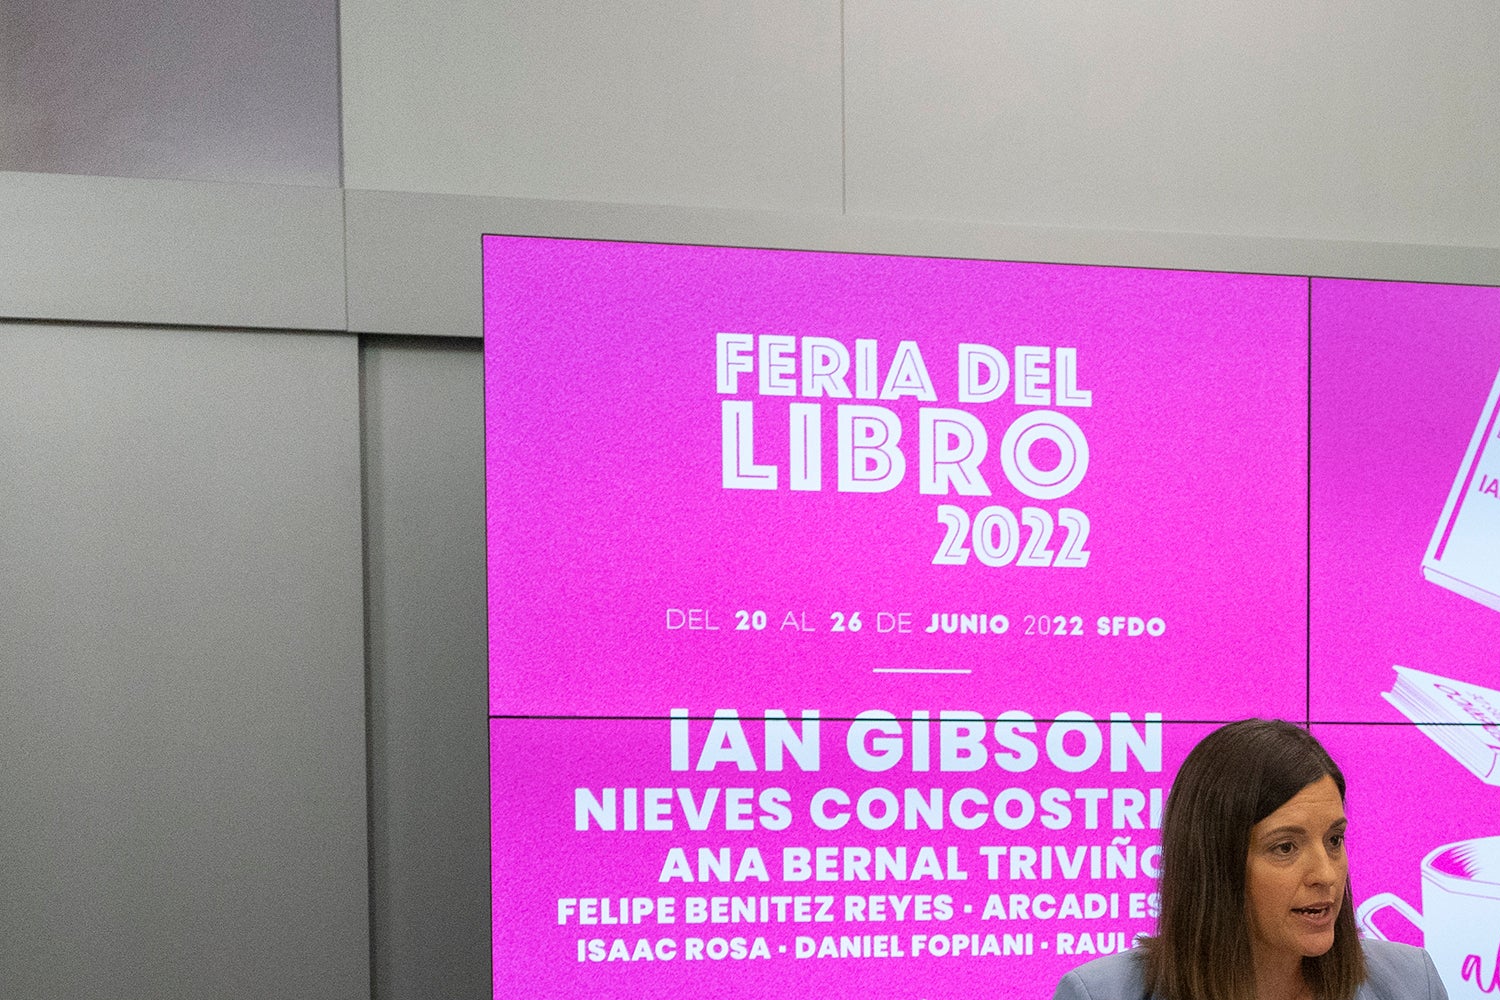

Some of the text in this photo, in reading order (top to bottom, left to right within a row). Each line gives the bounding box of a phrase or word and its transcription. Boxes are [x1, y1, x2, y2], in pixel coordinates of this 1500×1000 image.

[716, 332, 1092, 407] FERIA DEL
[721, 400, 1090, 500] LIBRO
[932, 504, 1091, 568] 2022
[666, 608, 1167, 637] DEL 20 AL 26 DE JUNIO 2022 SFDO
[670, 708, 1163, 773] IAN GIBSON
[575, 787, 1164, 832] NIEVES CONCOSTRI
[659, 847, 768, 884] ANA
[782, 846, 967, 882] BERNAL
[557, 897, 675, 925] FELIPE
[685, 896, 834, 924] BENITEZ
[845, 894, 954, 922] REYES
[981, 893, 1119, 920] ARCADI
[577, 938, 677, 962] ISAAC
[685, 936, 771, 961] ROSA
[795, 934, 904, 958] DANIEL
[911, 933, 1033, 957] FOPIANI
[1057, 932, 1133, 955] RAUL
